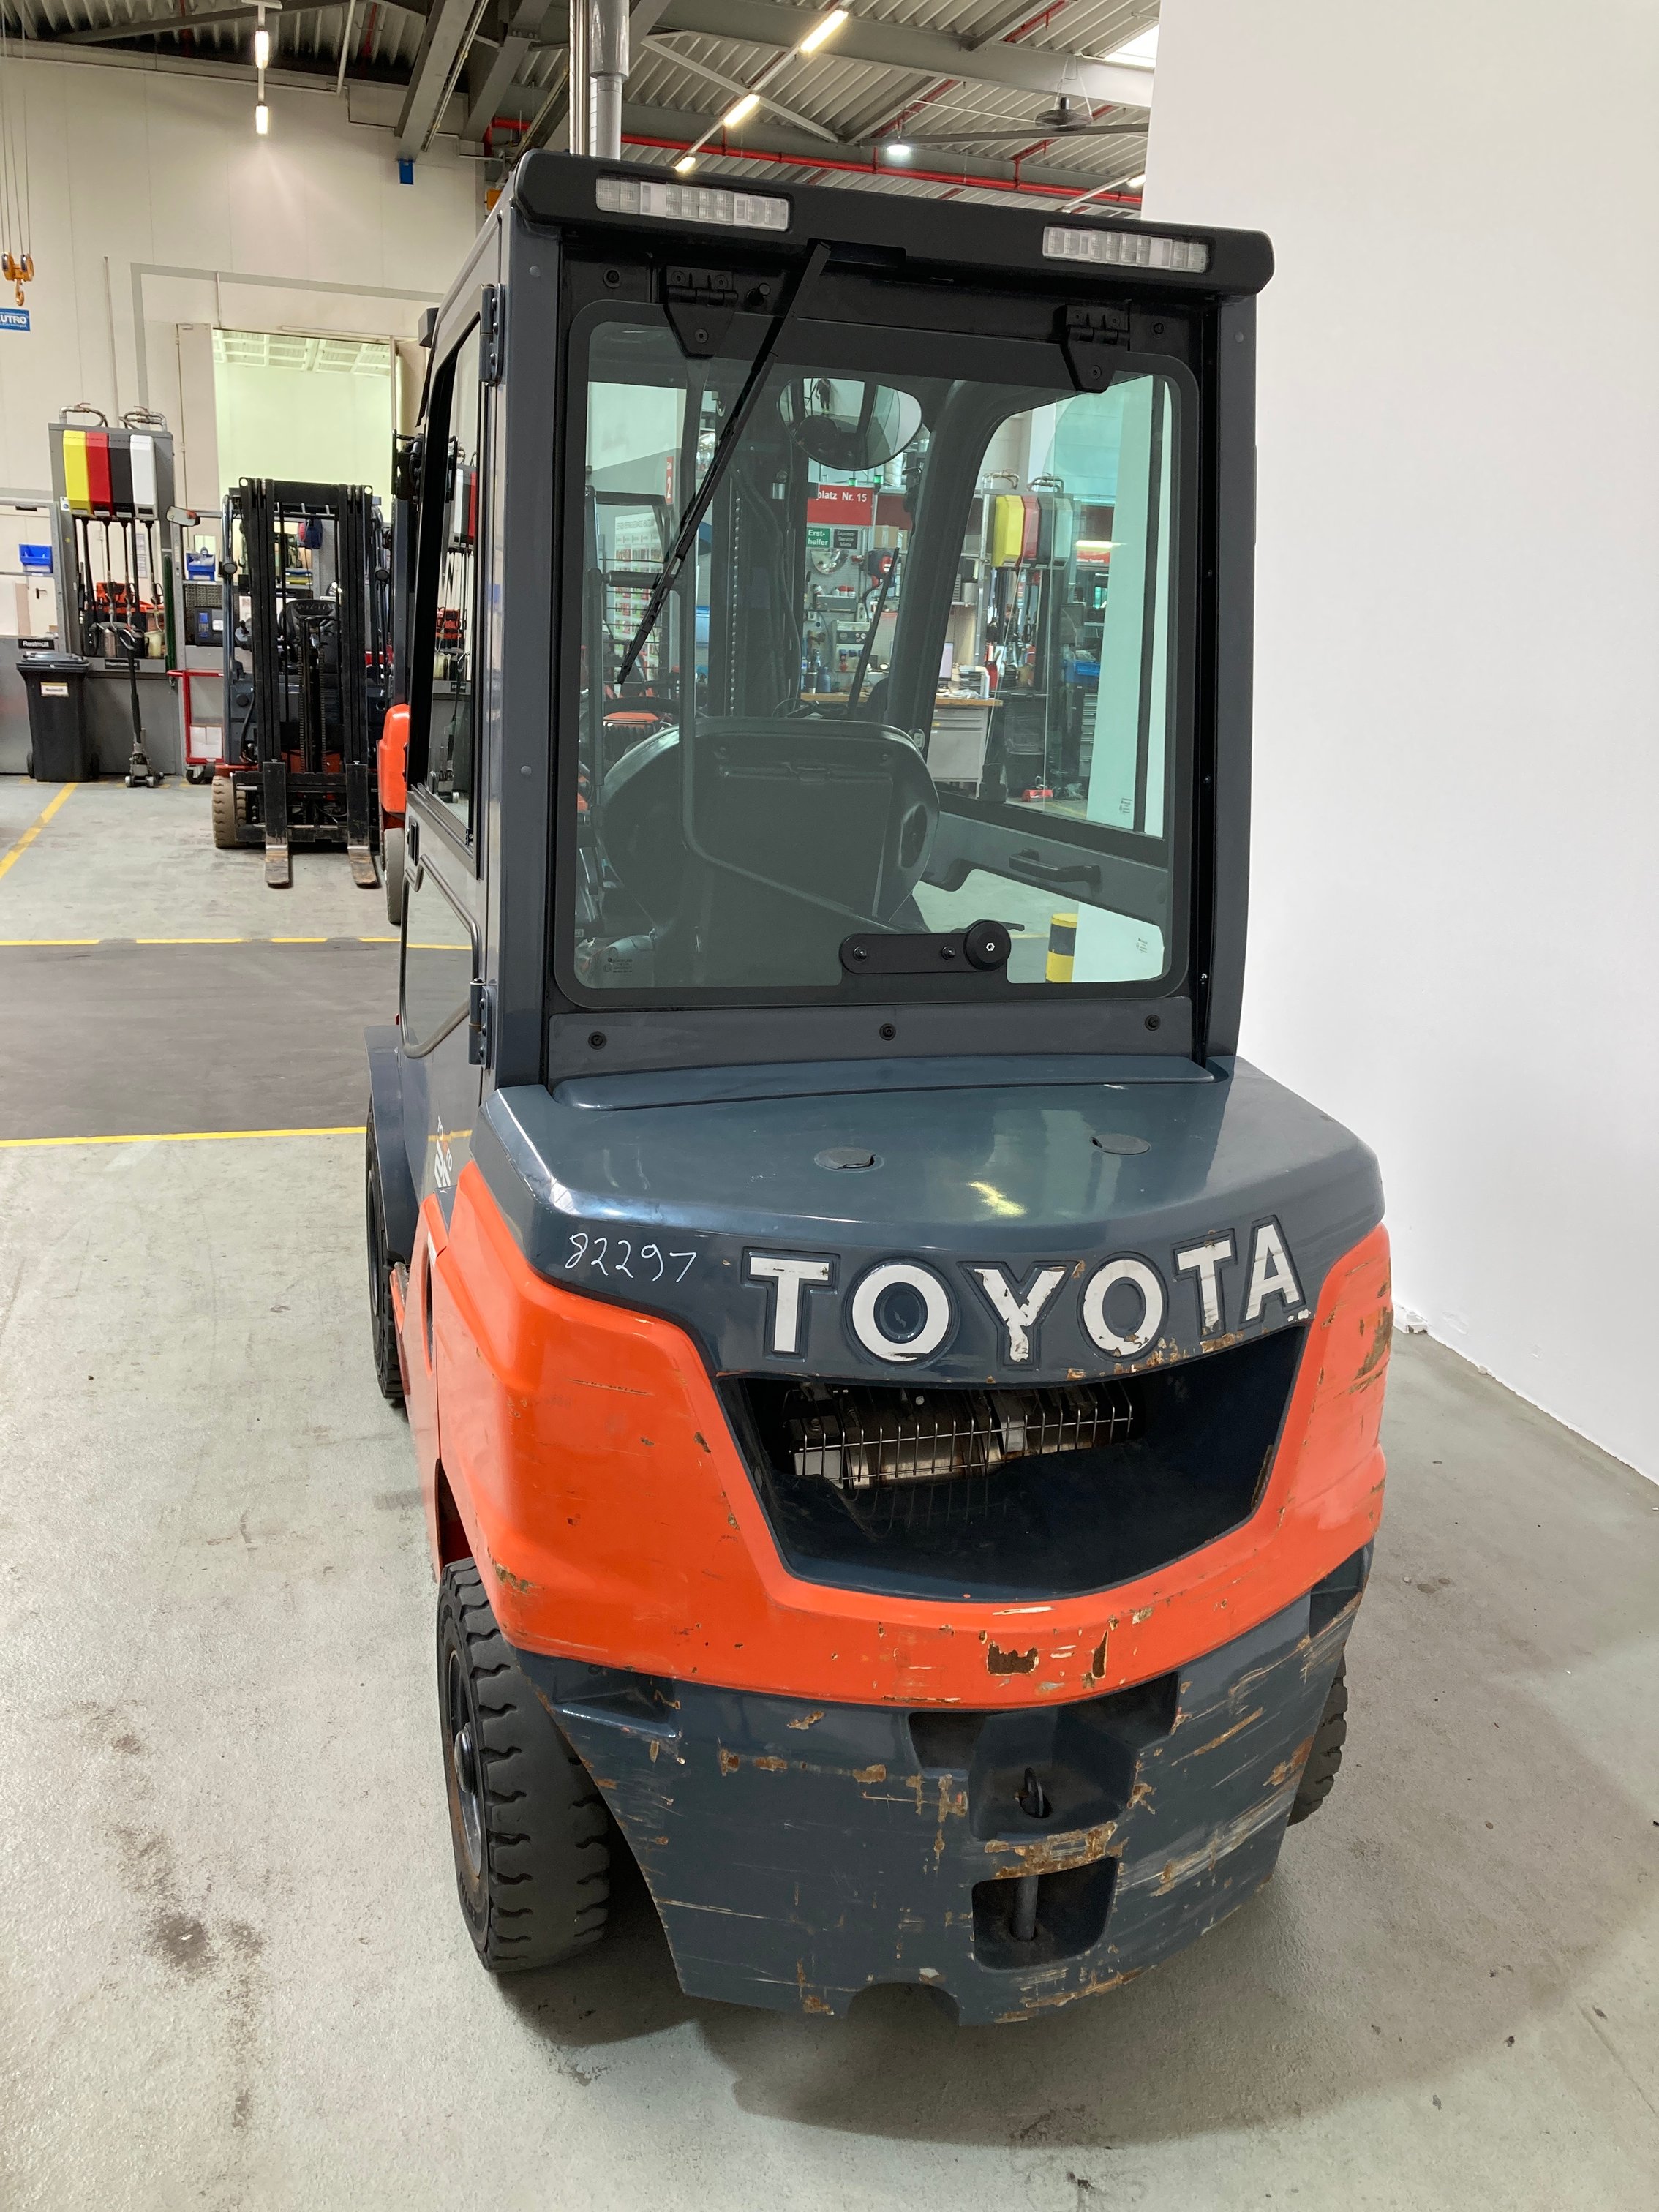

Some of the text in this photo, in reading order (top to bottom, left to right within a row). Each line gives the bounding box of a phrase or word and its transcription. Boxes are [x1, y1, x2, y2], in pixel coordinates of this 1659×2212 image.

[0, 315, 27, 324] UTRO
[842, 492, 854, 501] Nr.
[857, 493, 867, 502] 15
[808, 538, 829, 546] helfer
[565, 1232, 698, 1283] 82297
[747, 1222, 1301, 1363] TOYOTA
